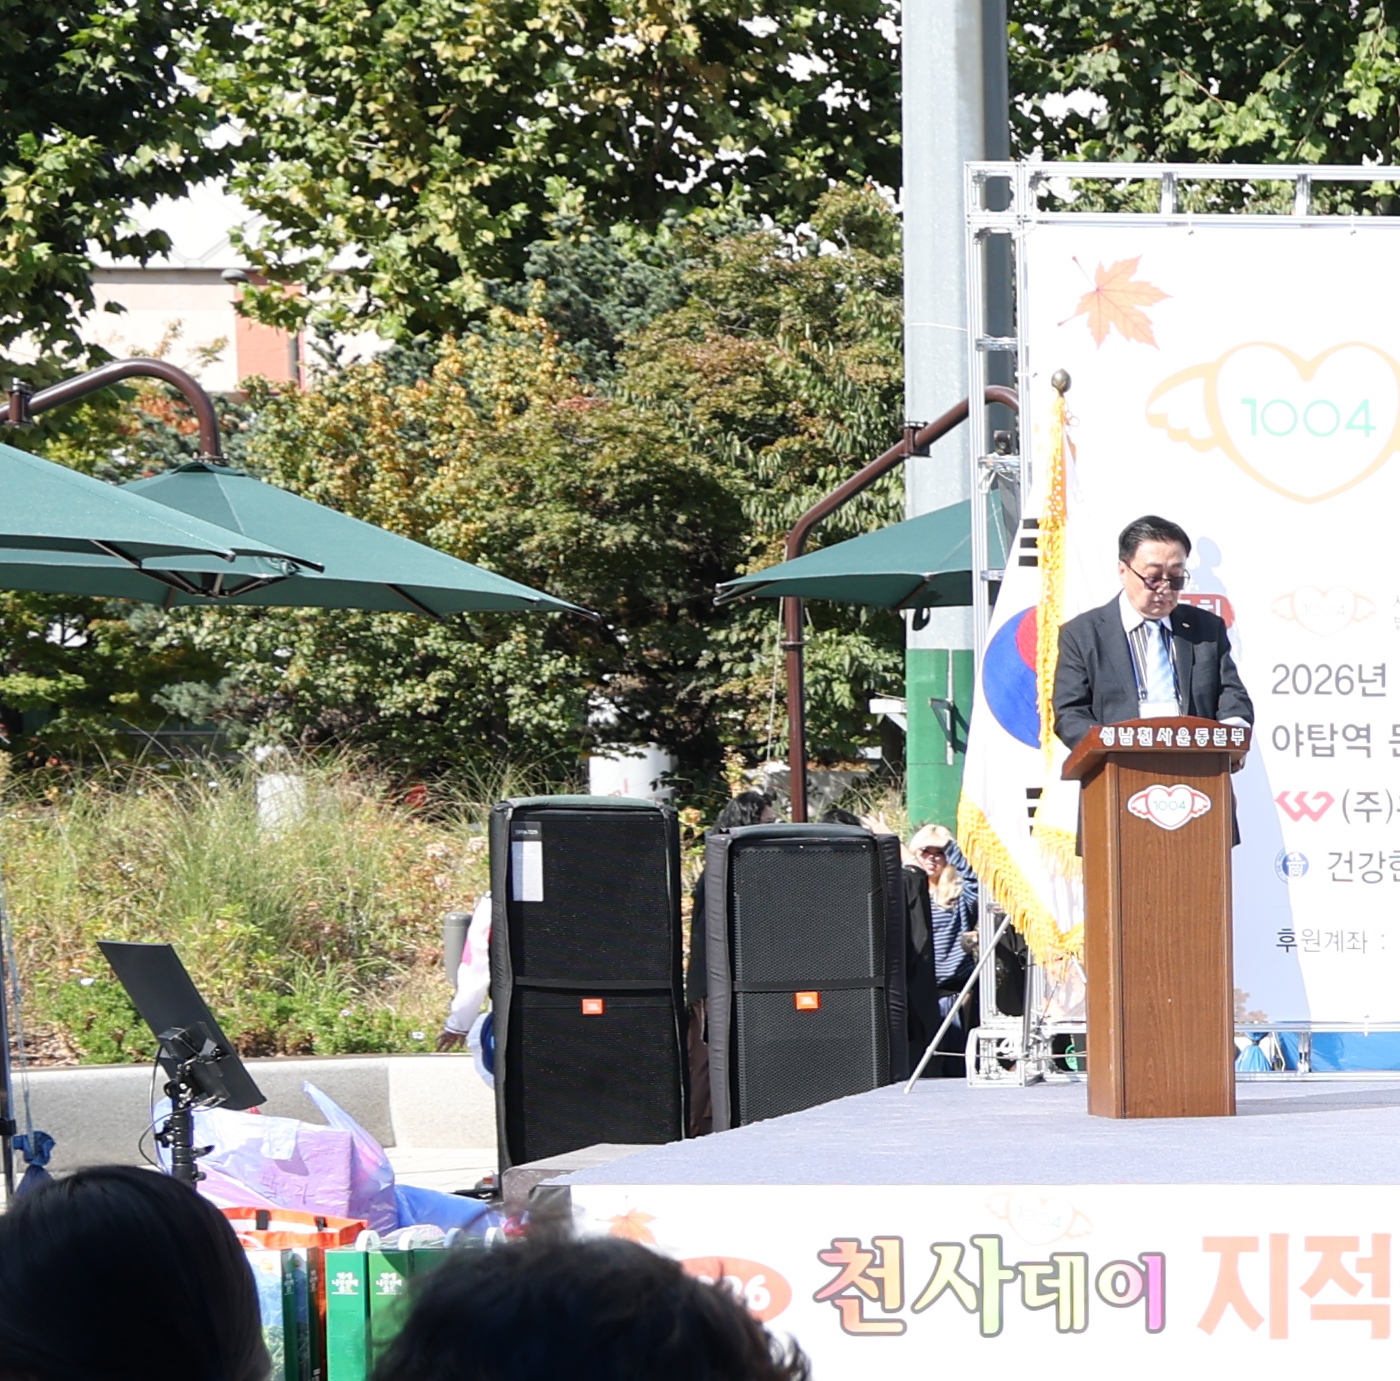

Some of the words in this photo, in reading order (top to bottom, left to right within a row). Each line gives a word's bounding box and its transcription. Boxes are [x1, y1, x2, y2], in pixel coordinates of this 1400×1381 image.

[1241, 398, 1376, 437] 1004
[1271, 662, 1387, 697] 2026년
[1099, 727, 1245, 747] 성남천사운동본부
[1272, 722, 1371, 758] 야탑역
[1154, 800, 1186, 811] 1004
[1275, 927, 1368, 955] 후원계좌
[1016, 1205, 1062, 1231] 1004
[812, 1233, 1166, 1339] 천사데이
